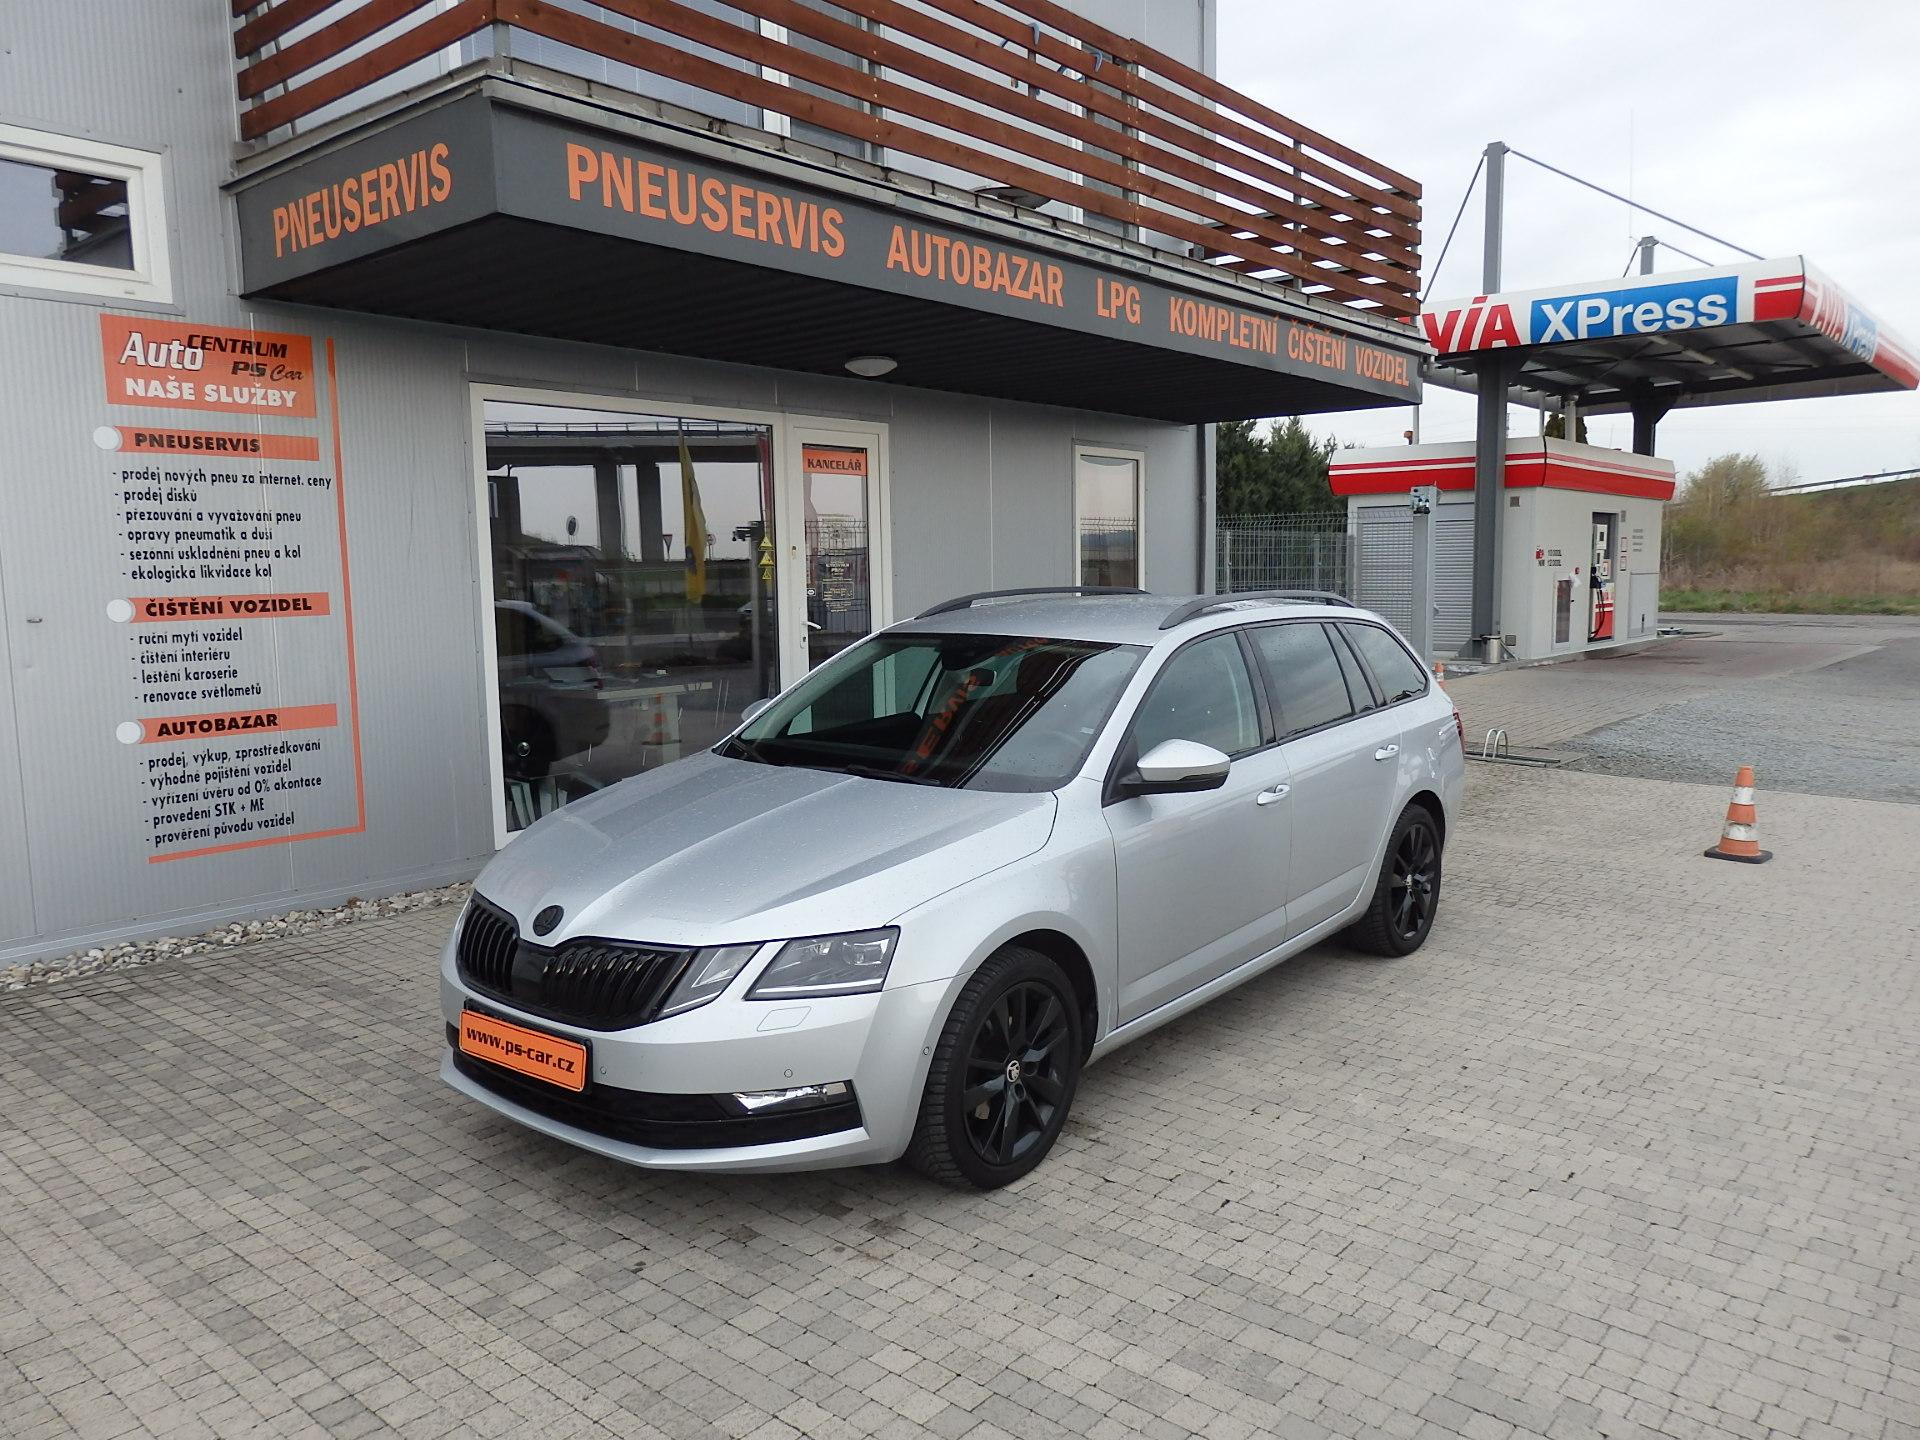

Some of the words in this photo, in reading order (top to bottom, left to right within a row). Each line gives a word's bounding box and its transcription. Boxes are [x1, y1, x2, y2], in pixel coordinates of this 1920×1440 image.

[273, 143, 452, 258] PNEUSERVIS
[566, 142, 845, 258] PNEUSERVIS
[886, 224, 1064, 307] AUTOBAZAR
[1097, 278, 1141, 325] LPG
[1169, 296, 1279, 354] KOMPLETNÍ
[1288, 319, 1347, 371] ČIŠTĚNÍ
[1355, 345, 1409, 387] VOZIDEL
[1539, 294, 1728, 343] XPress
[119, 331, 205, 371] Auto
[187, 334, 288, 359] CENTRUM
[231, 361, 267, 377] PS
[270, 364, 304, 382] Car
[125, 375, 196, 401] NAŠE
[204, 382, 297, 408] SLUŽBY
[135, 432, 261, 452] PNEUSERVIS
[807, 458, 862, 471] KANCELÁŘ
[122, 467, 161, 485] prodej
[165, 468, 207, 486] nových
[211, 473, 238, 486] pneu
[242, 474, 255, 484] za
[307, 477, 332, 490] ceny
[124, 486, 163, 505] prodej
[126, 508, 192, 524] přezouvání
[196, 511, 203, 521] a
[208, 509, 272, 525] vyvažování
[276, 512, 302, 525] pneu
[127, 531, 170, 544] opravy
[175, 526, 236, 544] pneumatik
[240, 531, 247, 540] a
[179, 545, 241, 560] uskladnění
[244, 549, 271, 562] pneu
[274, 549, 281, 558] a
[284, 544, 301, 558] kol
[200, 563, 251, 579] likvidace
[255, 563, 272, 577] kol
[145, 597, 223, 617] ČIŠTĚNÍ
[230, 597, 312, 613] VOZIDEL
[139, 631, 168, 645] ruční
[202, 626, 243, 642] vozidel
[140, 650, 178, 664] čištění
[181, 647, 230, 662] interiéru
[141, 669, 181, 684] leštění
[184, 665, 238, 681] karoserie
[143, 690, 197, 703] renovace
[201, 682, 262, 699] světlometů
[157, 713, 278, 737] AUTOBAZAR
[235, 738, 321, 762] zprostředkování
[204, 763, 250, 784] pojištění
[254, 758, 292, 775] vozidel
[237, 781, 251, 796] od
[254, 778, 270, 793] 0%
[274, 776, 322, 791] akontace
[153, 805, 211, 829] provedení
[214, 801, 236, 817] STK
[250, 797, 265, 813] ME
[214, 817, 253, 839] původu
[257, 811, 295, 829] vozidel
[466, 1027, 575, 1073] www.ps-car.cz
